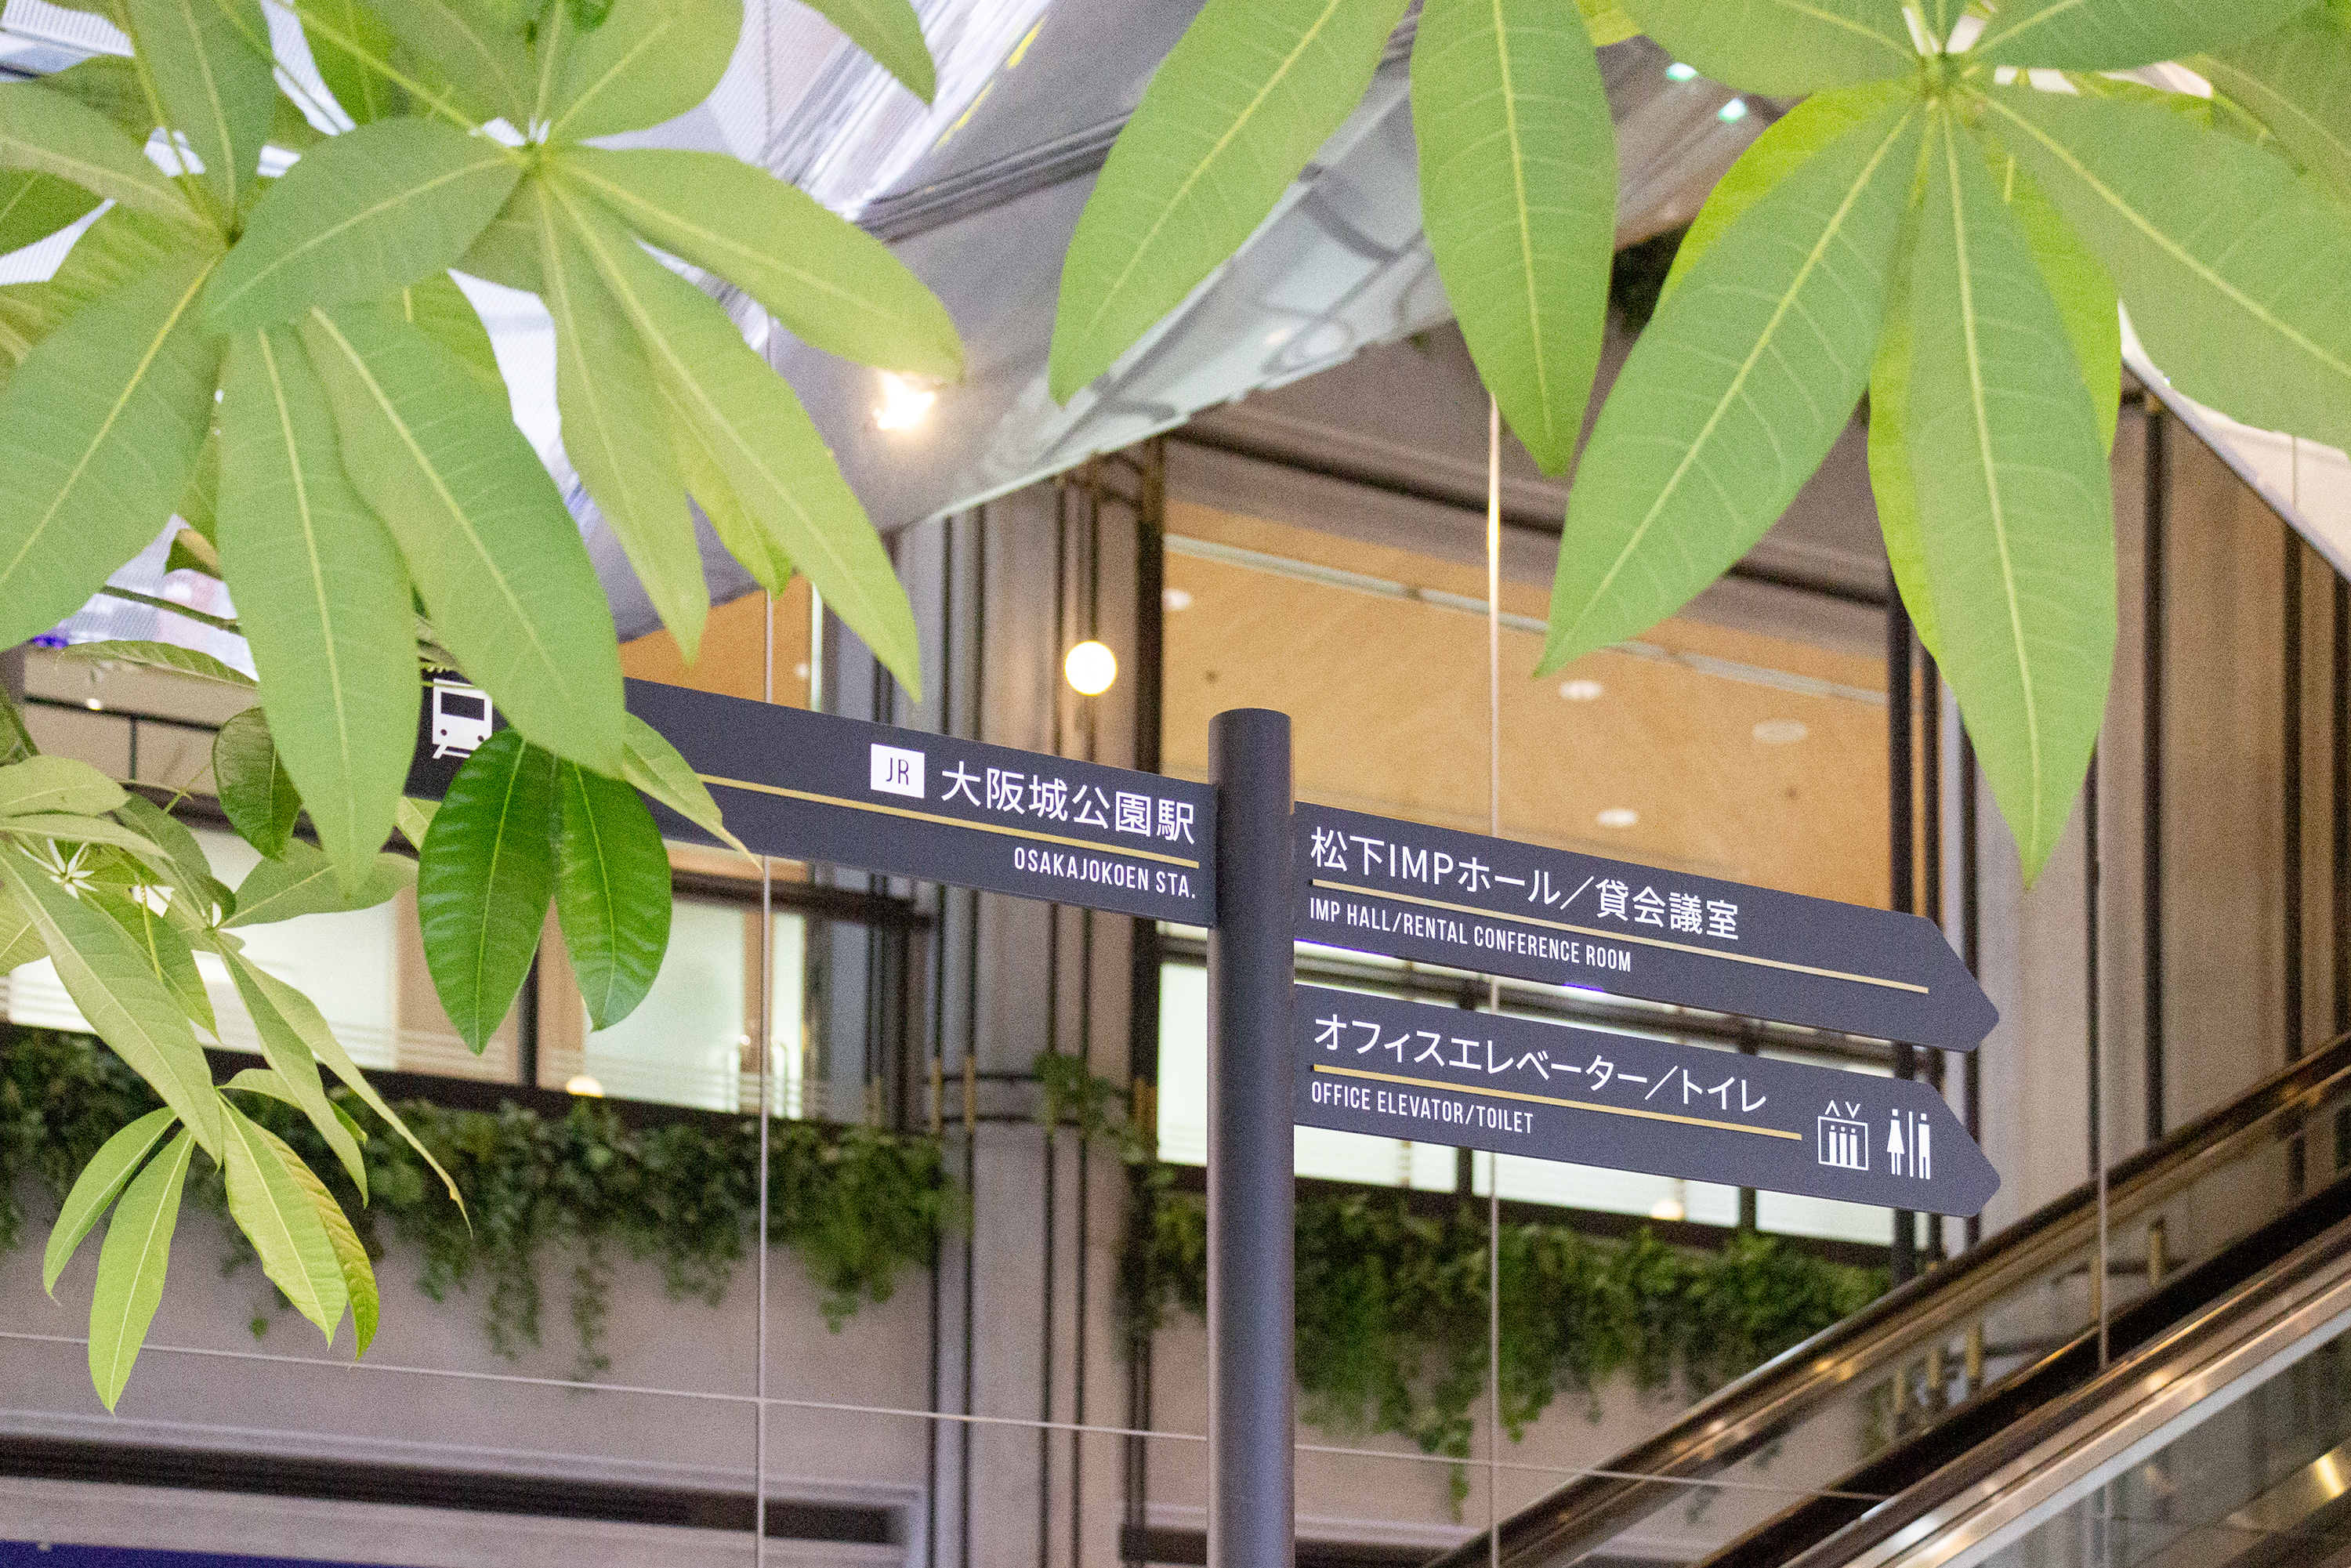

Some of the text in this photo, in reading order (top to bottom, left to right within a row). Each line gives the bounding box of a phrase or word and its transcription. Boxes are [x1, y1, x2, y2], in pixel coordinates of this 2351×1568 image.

[886, 757, 1195, 845] JR 大阪城公園駅
[1014, 846, 1196, 900] OSAKAJOKOEN STA.
[1310, 897, 1632, 973] IMP HALL/RENTAL CONFERENCE ROOM
[1311, 1081, 1534, 1135] OFFICE ELEVATOR/TOILET
